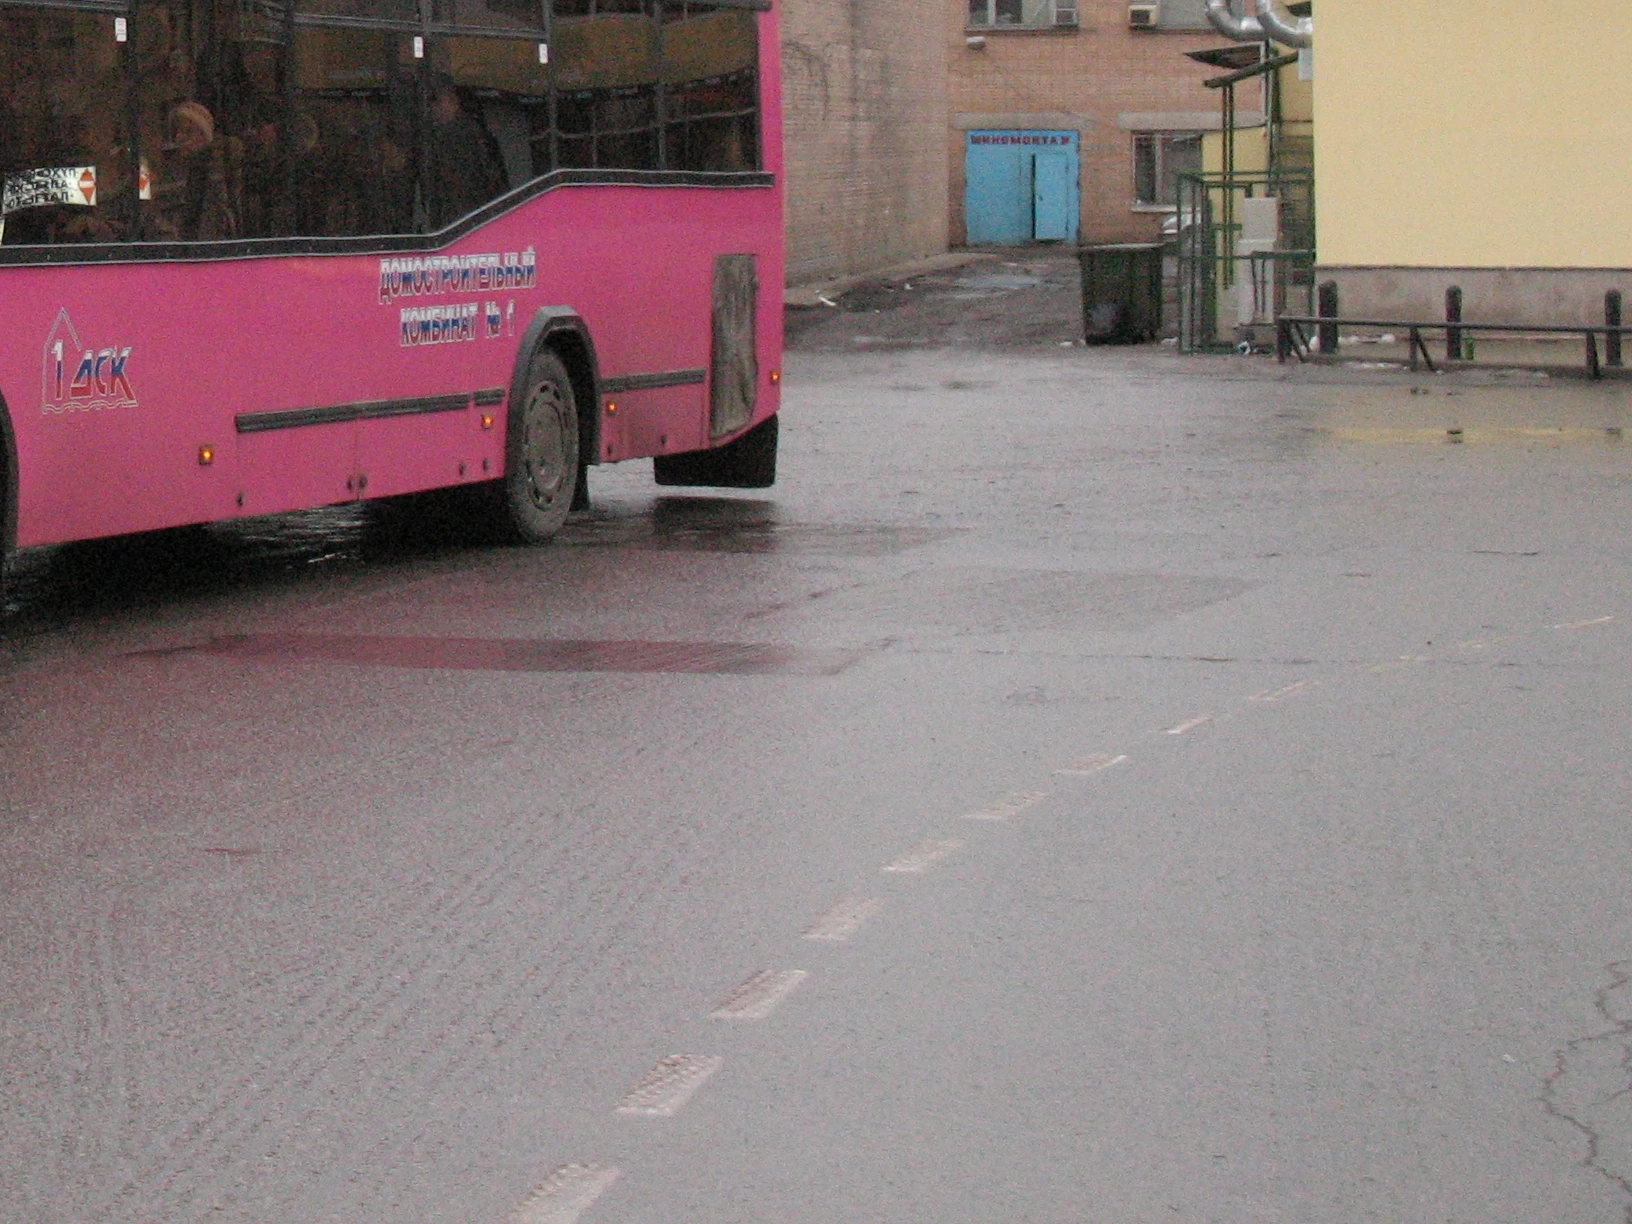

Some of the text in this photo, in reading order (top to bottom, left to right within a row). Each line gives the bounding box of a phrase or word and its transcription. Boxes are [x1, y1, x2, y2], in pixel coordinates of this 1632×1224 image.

[378, 245, 537, 305] ДОМОСТРОИТЕЛЬНЫЙ
[400, 302, 479, 347] КОМБИНАТ
[506, 299, 515, 337] 1
[51, 339, 139, 407] 1 ДСК
